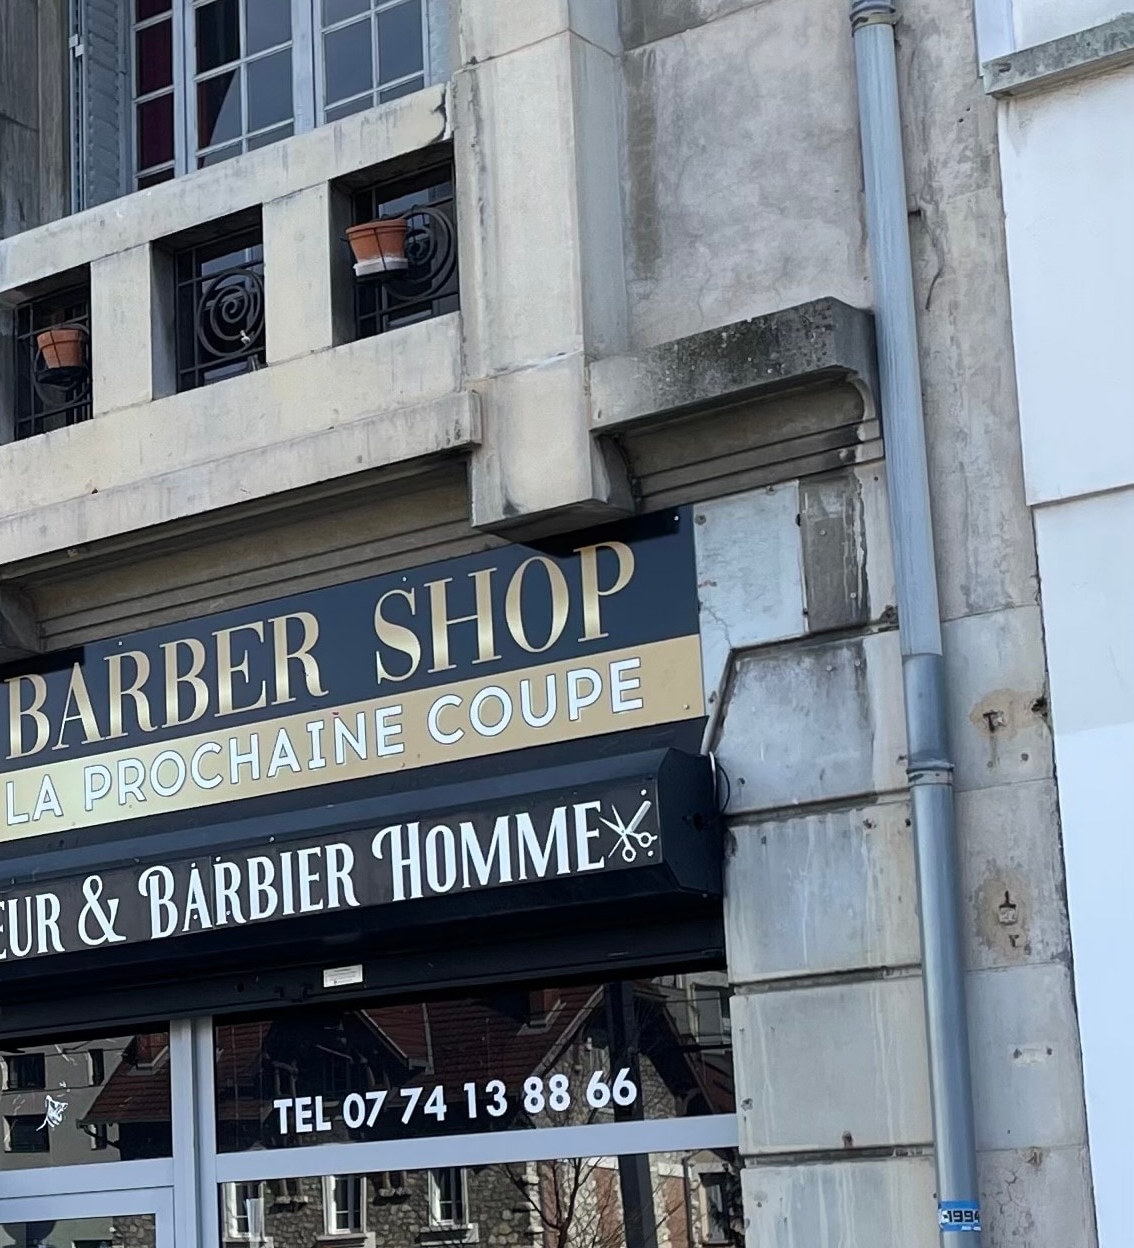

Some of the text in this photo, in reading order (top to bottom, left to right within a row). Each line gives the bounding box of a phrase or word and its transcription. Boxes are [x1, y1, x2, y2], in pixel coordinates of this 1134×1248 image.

[3, 541, 636, 761] BARBER SHOP
[5, 656, 644, 826] LA PROCHAINE COUPE
[77, 873, 127, 946] &
[138, 841, 361, 940] BARBIER
[371, 799, 605, 902] HOMME
[273, 1067, 638, 1135] TEL 07 74 13 88 66
